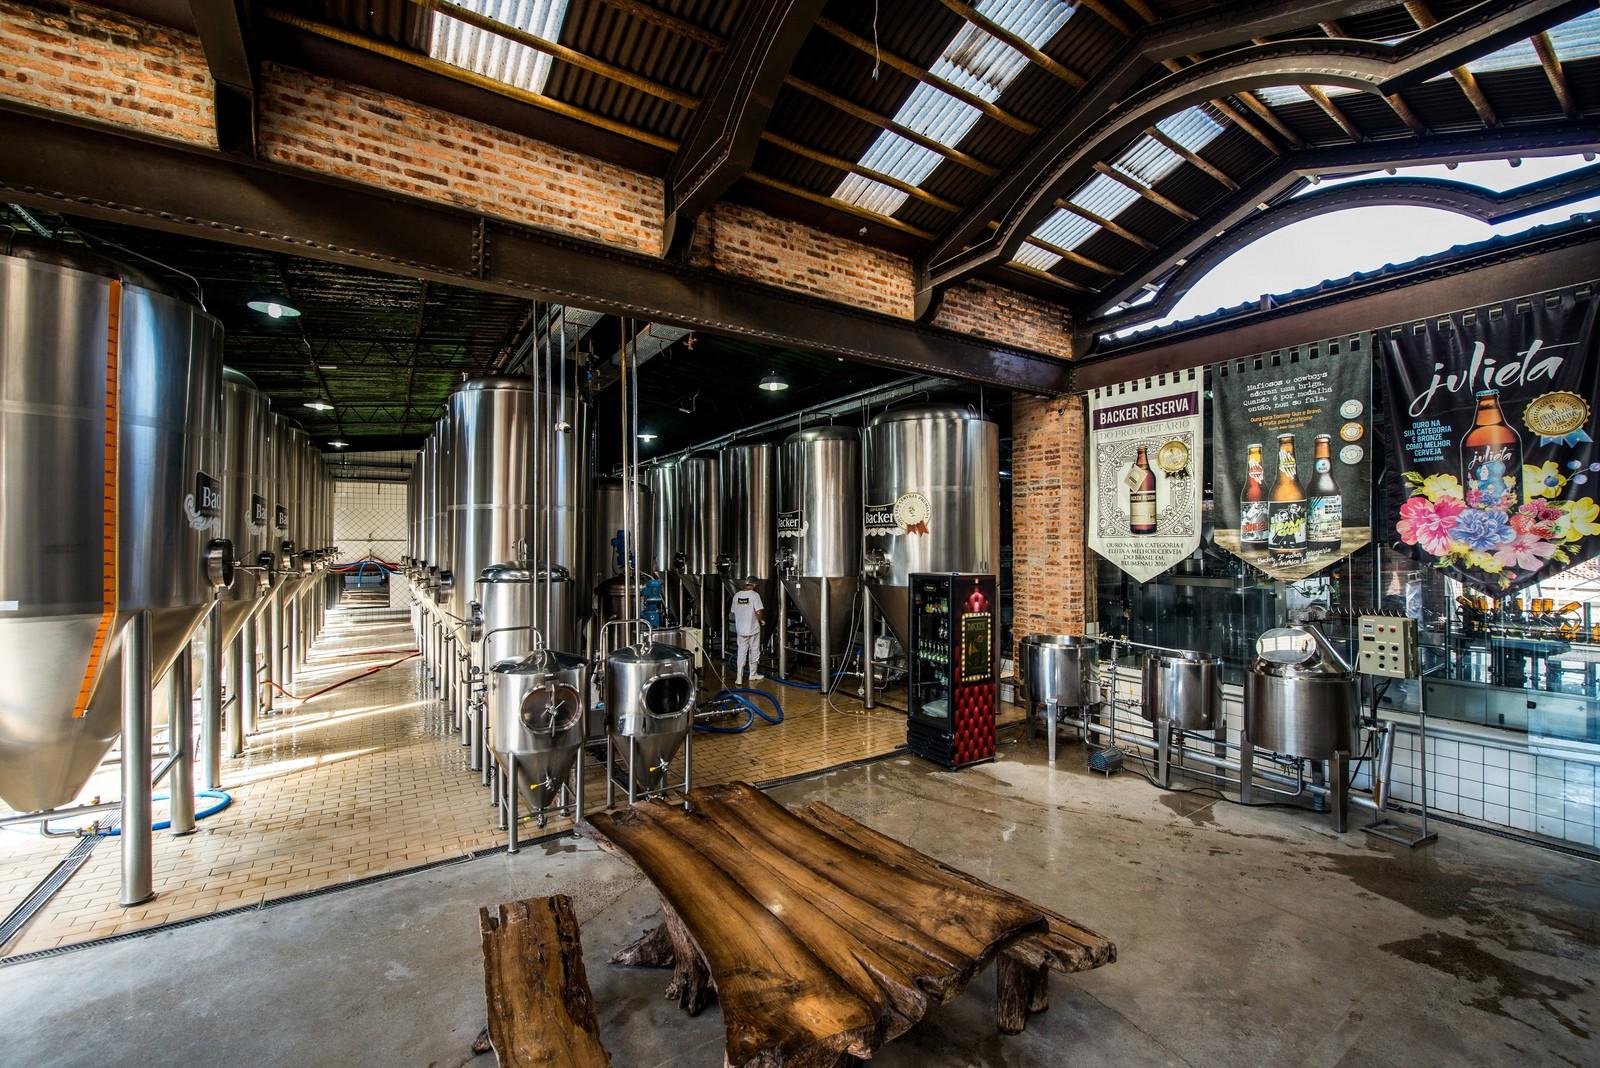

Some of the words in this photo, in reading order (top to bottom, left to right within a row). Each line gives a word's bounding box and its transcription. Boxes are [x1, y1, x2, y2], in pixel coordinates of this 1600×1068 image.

[1293, 372, 1328, 383] cowboys
[1408, 339, 1581, 417] julieta
[1243, 397, 1270, 407] Quando
[1280, 393, 1295, 402] por
[1100, 407, 1138, 425] BACKER
[1141, 398, 1189, 418] RESERVA
[1412, 421, 1430, 429] OURO
[1430, 419, 1441, 427] NA
[1100, 431, 1114, 440] DO
[1403, 430, 1416, 438] SUA
[1416, 425, 1452, 436] CATEGORIA
[1417, 433, 1443, 443] BRONZE
[1406, 443, 1423, 451] COMO
[1424, 440, 1451, 449] MELHOR
[1414, 448, 1442, 457] CERVEJA
